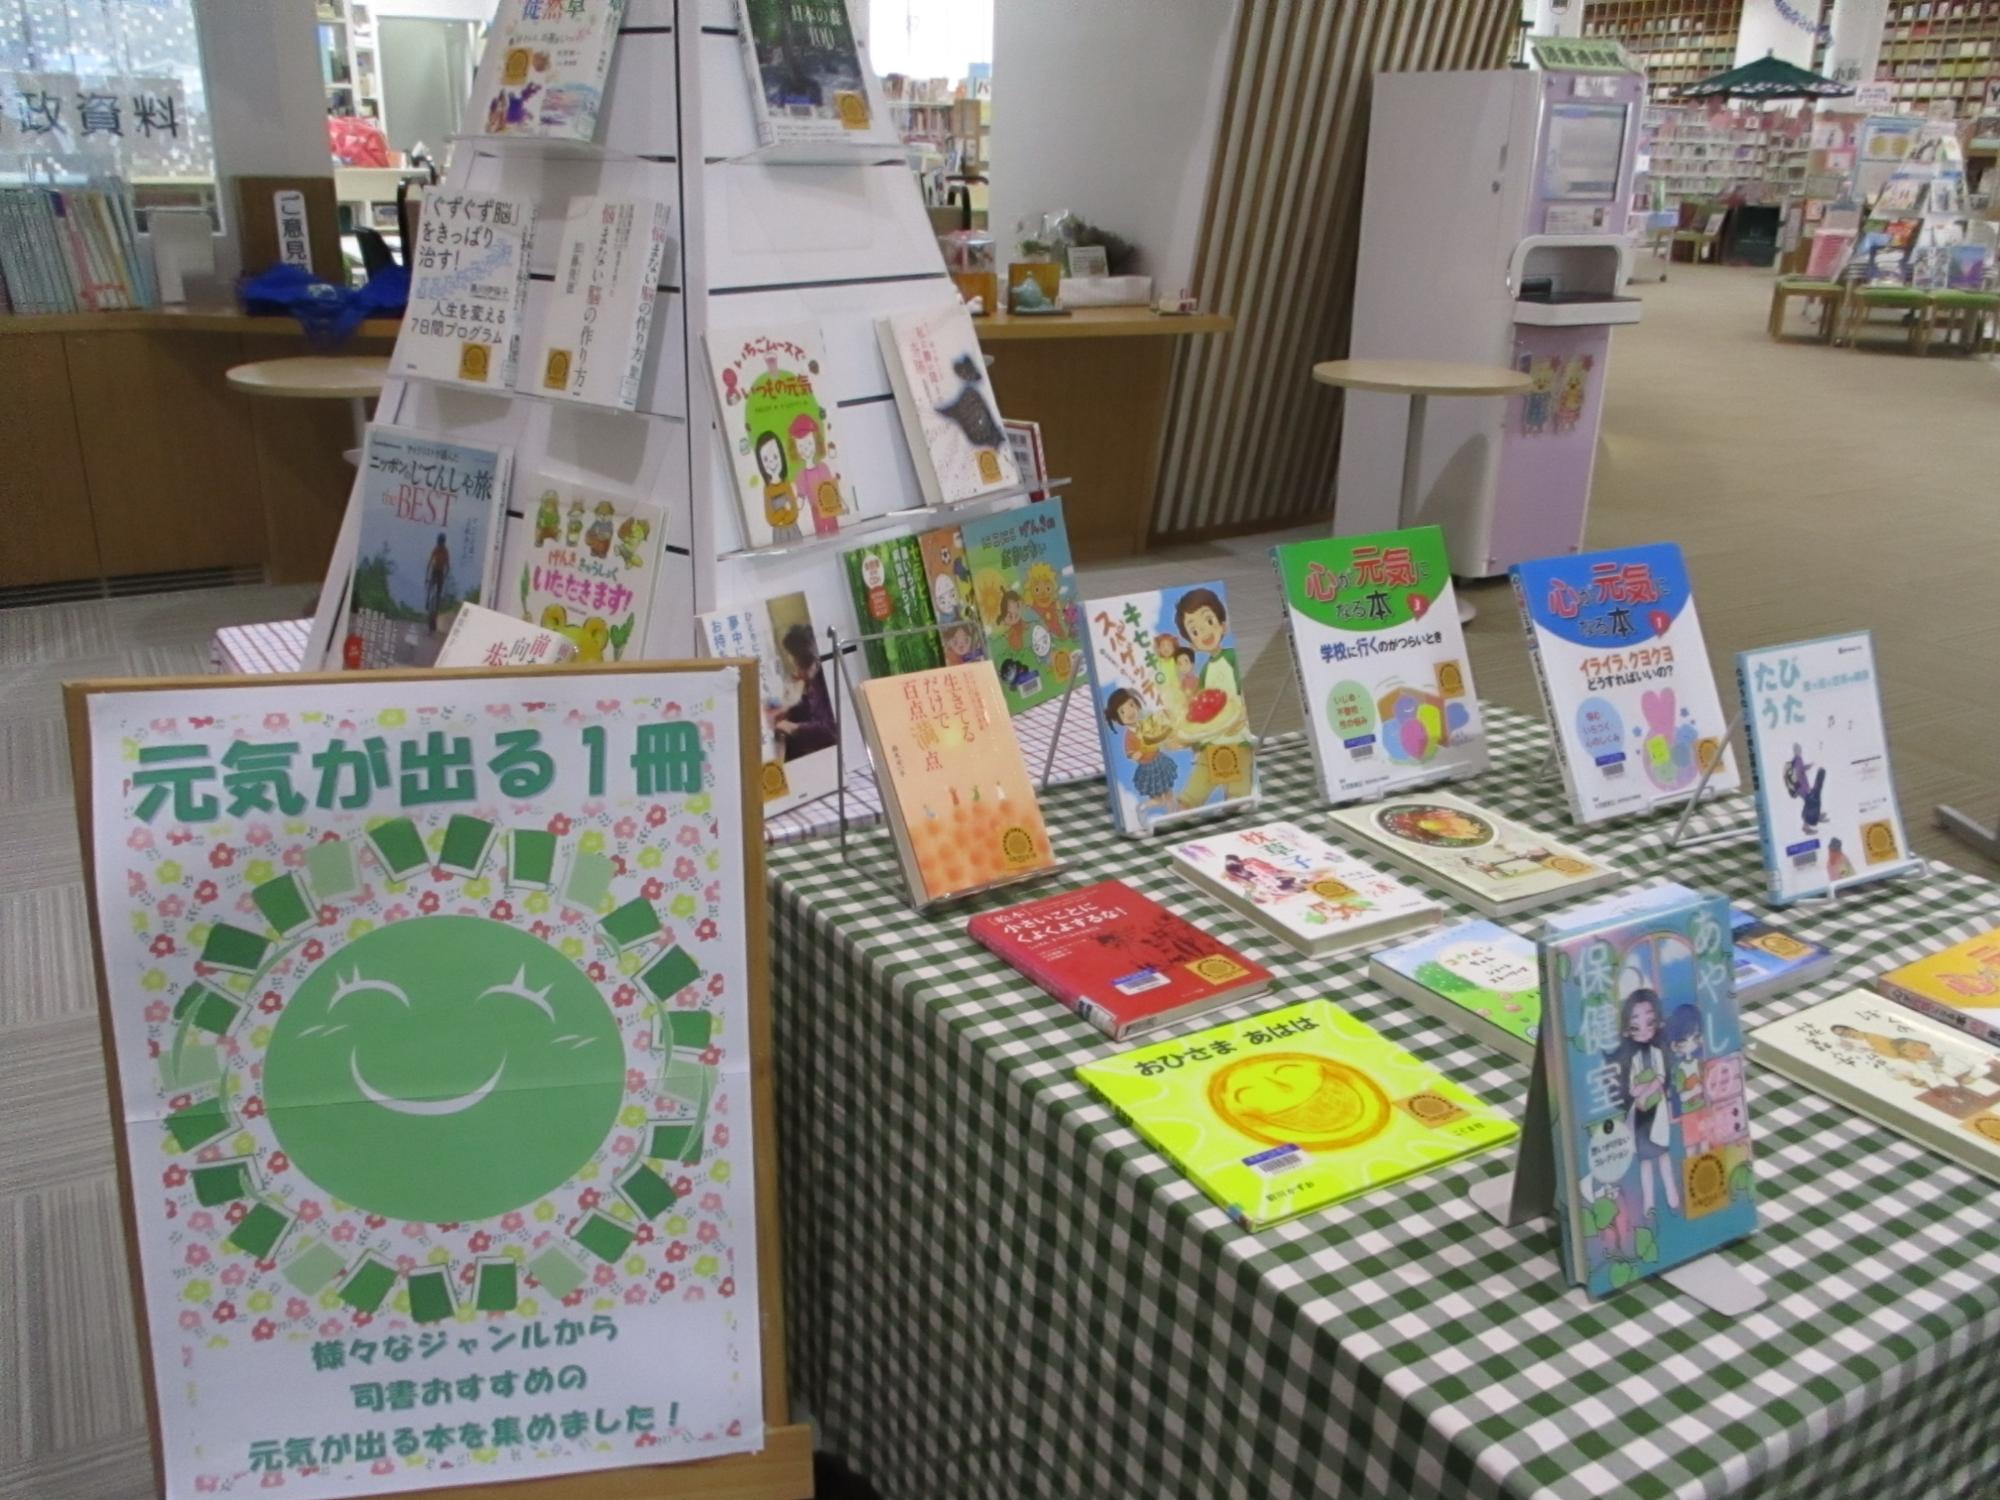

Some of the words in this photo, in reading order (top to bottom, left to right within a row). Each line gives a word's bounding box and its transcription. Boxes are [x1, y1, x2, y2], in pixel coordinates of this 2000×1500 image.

[0, 90, 179, 138] 政資料
[280, 194, 311, 274] ご意見
[423, 221, 494, 248] をきっぱり
[410, 317, 503, 344] 7日間プログラム
[432, 301, 506, 325] 人生を変える
[734, 336, 808, 368] いちごムースで
[741, 374, 814, 400] いつもの元気
[396, 484, 459, 528] BEST
[1306, 546, 1433, 602] 心が元気に
[1548, 562, 1672, 618] 心が元気に
[1335, 590, 1394, 621] なる本
[1577, 606, 1635, 637] なる本
[1319, 630, 1443, 664] 学校に行くのがつらいとき
[1754, 657, 1801, 692] たび
[903, 679, 943, 772] 百点満点
[923, 676, 951, 729] だけで
[944, 673, 976, 743] 生きてる
[1762, 694, 1806, 730] うた
[133, 720, 705, 824] 元気が出る1冊
[1004, 902, 1099, 934] 小さいことに
[1692, 910, 1731, 1055] あやし
[1133, 1040, 1239, 1077] おひさま
[1243, 1015, 1322, 1046] あはは
[1575, 941, 1626, 1114] 保健室
[310, 1314, 619, 1373] 様々なジャンルから
[350, 1364, 589, 1413] 司書おすすめの
